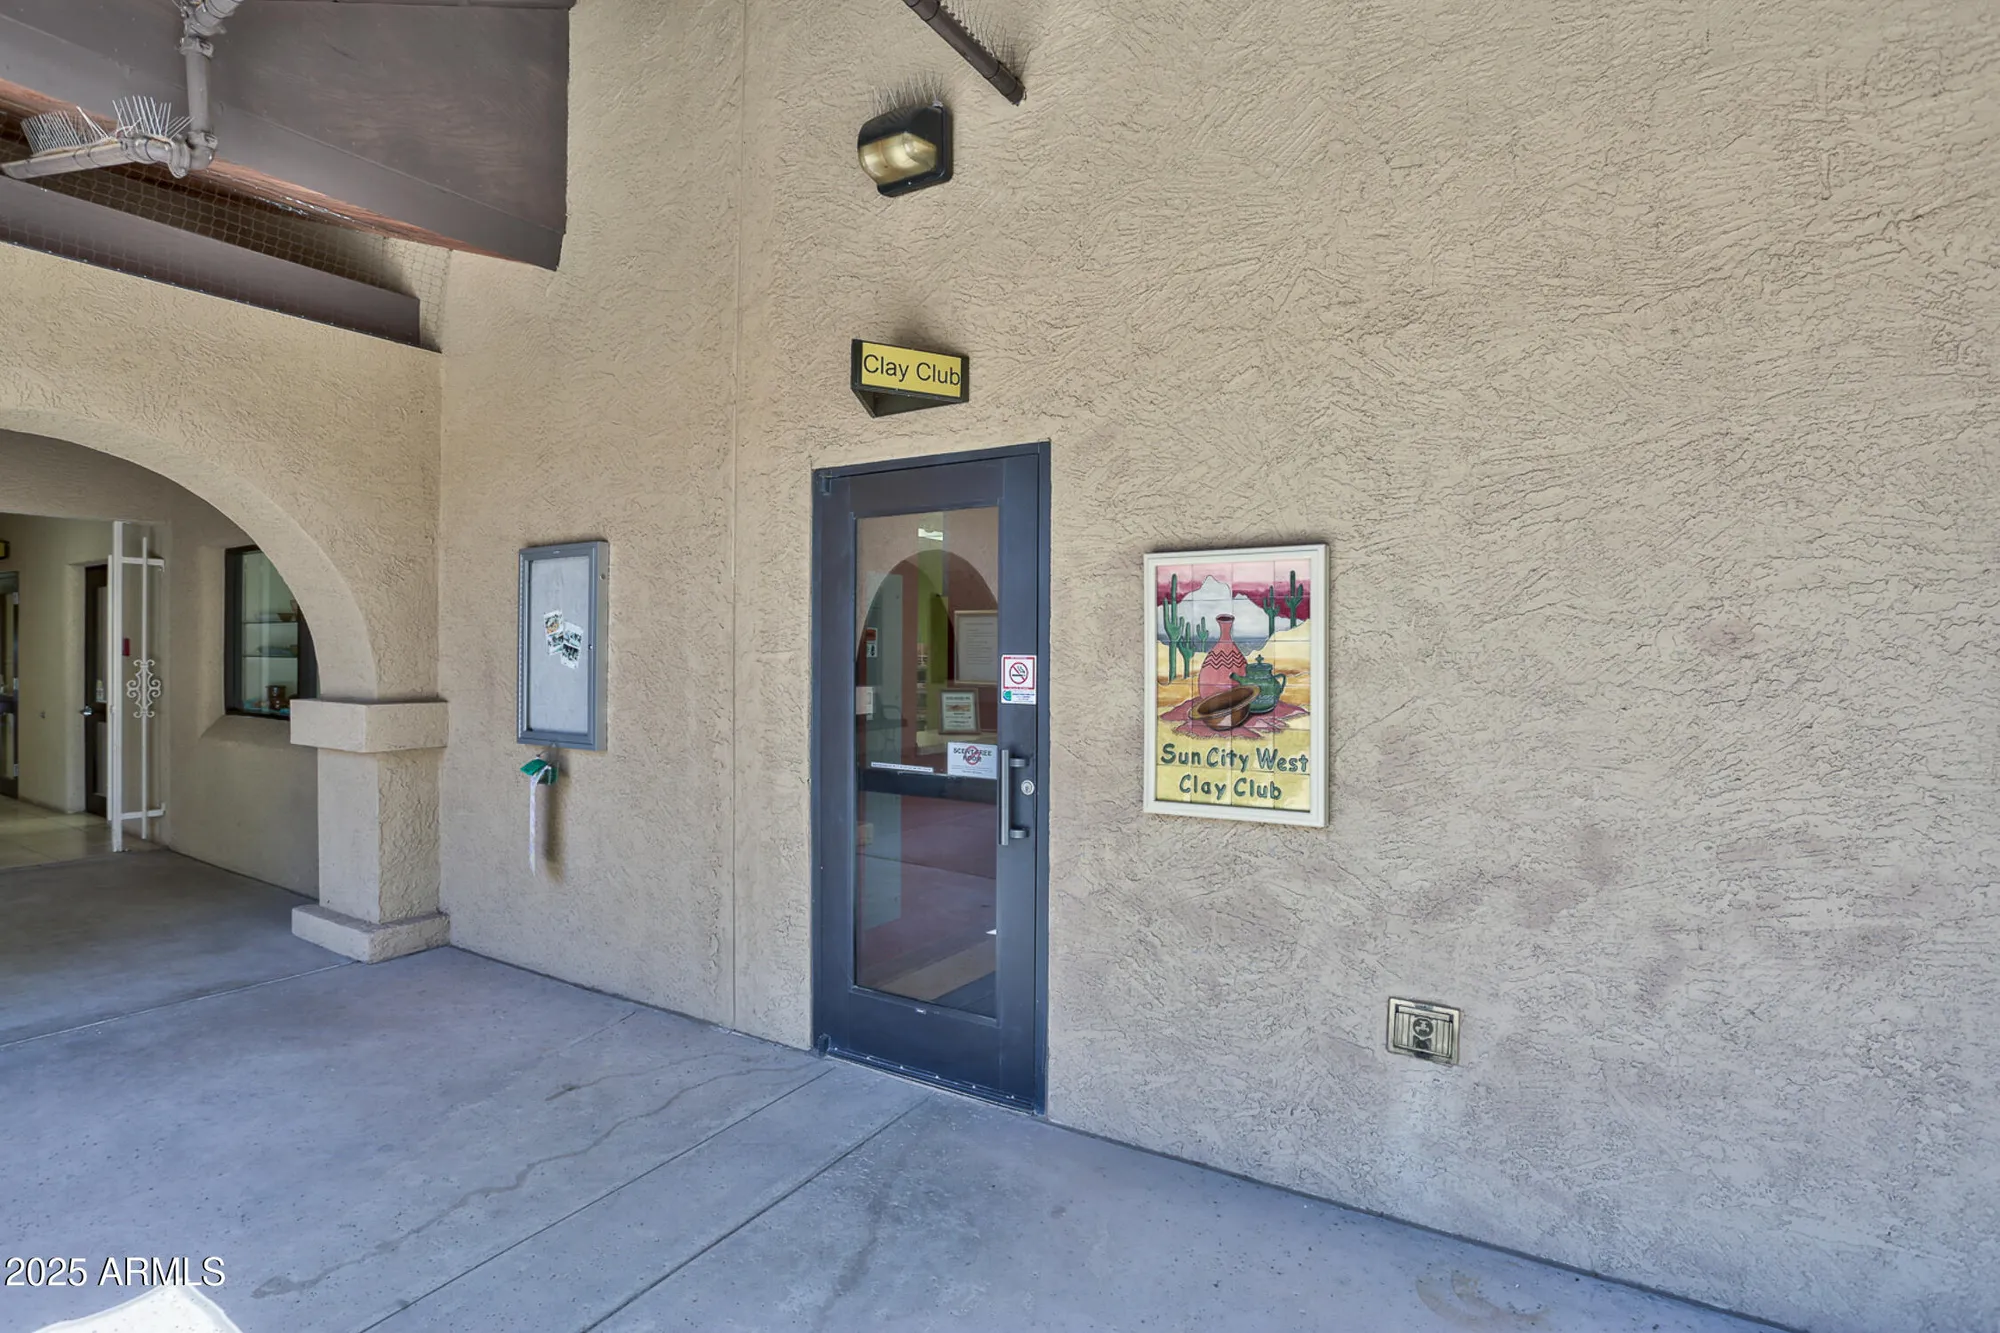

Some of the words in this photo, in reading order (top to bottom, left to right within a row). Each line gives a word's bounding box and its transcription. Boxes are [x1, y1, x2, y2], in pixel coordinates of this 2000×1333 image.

[863, 354, 910, 382] Clay
[916, 362, 961, 386] Club
[1160, 743, 1202, 766] Sun
[1206, 747, 1249, 773] City
[1256, 747, 1309, 772] West
[1179, 774, 1227, 800] Clay
[1234, 777, 1282, 800] Club
